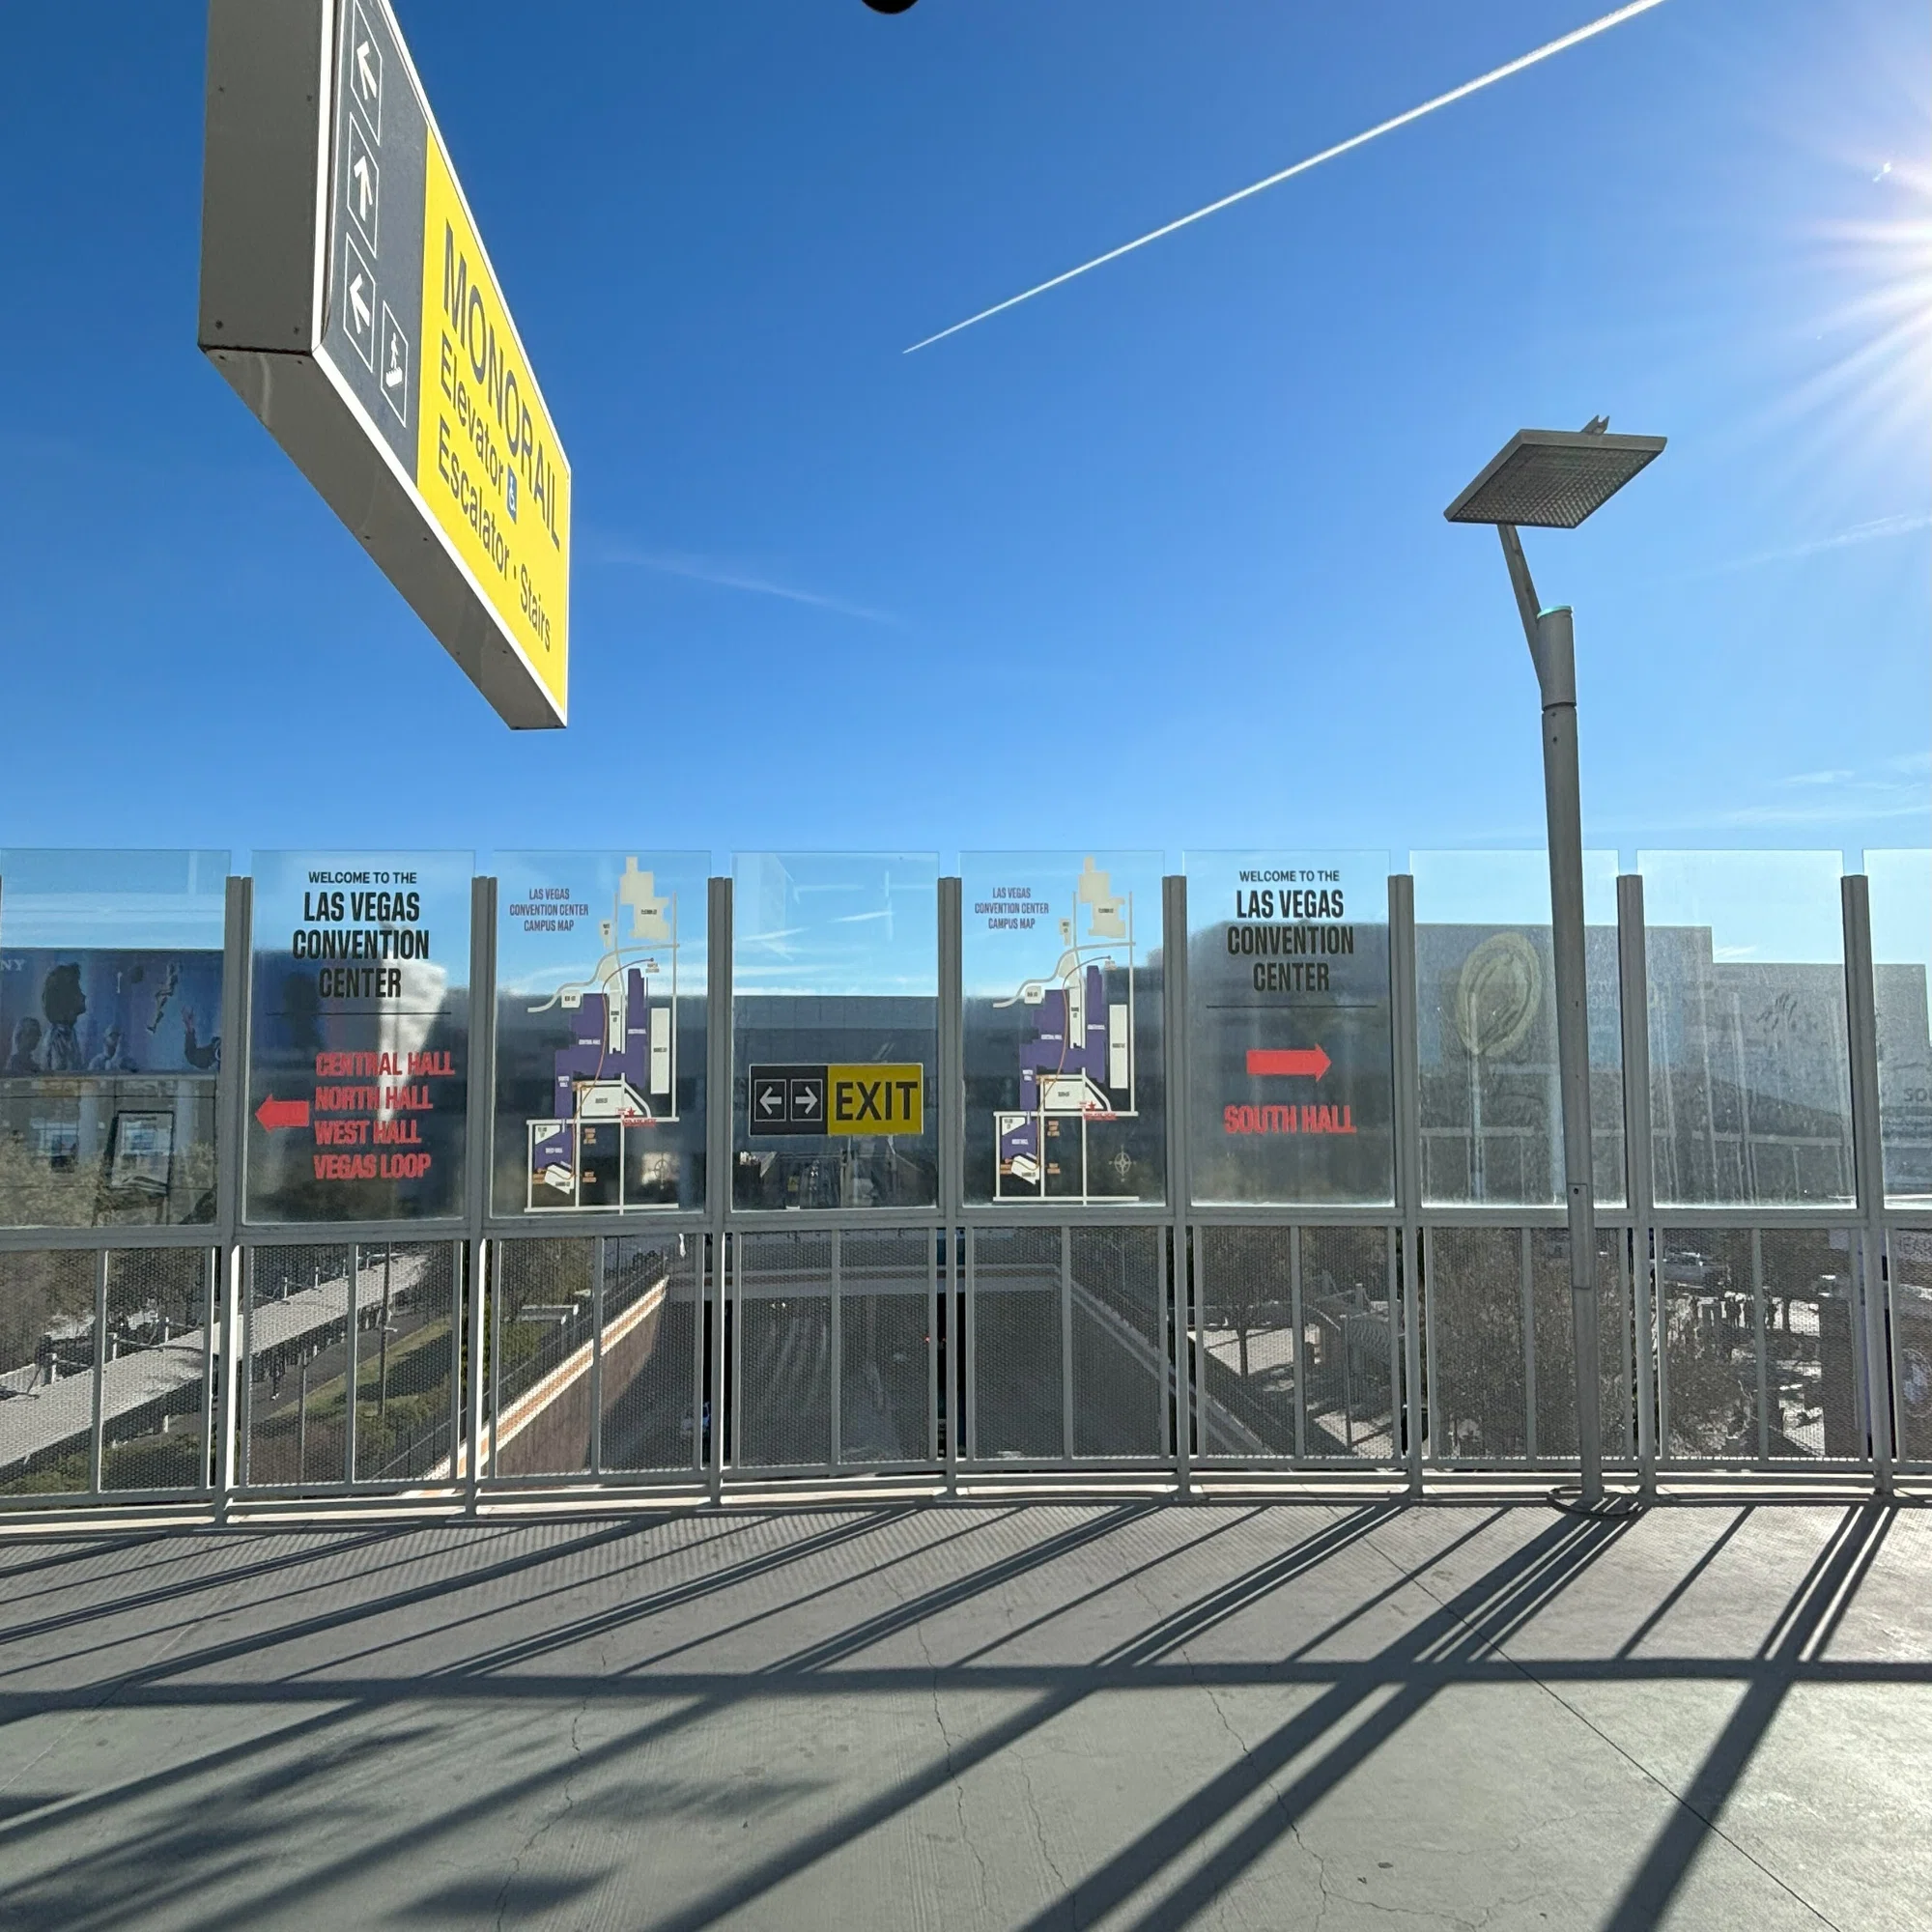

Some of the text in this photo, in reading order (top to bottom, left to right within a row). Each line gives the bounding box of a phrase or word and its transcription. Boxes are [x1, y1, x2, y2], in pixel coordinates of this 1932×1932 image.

[443, 217, 560, 553] MONORAIL
[440, 328, 504, 489] Elevator
[438, 413, 551, 653] Escalator Stairs
[308, 871, 417, 884] WELCOME TO THE
[1239, 870, 1340, 882] WELCOME TO THE
[528, 888, 570, 900] LAS VEGAS
[992, 887, 1031, 898] LAS VEGAS
[1236, 889, 1344, 919] LAS VEGAS
[304, 892, 420, 922] LAS VEGAS
[509, 903, 589, 916] CONVENTION CENTER
[974, 902, 1049, 914] CONVENTION CENTER
[524, 920, 575, 932] CAMPUS MAP
[988, 918, 1036, 929] CAMPUS MAP
[293, 929, 429, 960] CONVENTION
[1227, 925, 1353, 955] CONVENTION
[319, 967, 402, 998] CENTER
[1253, 962, 1330, 991] CENTER
[316, 1050, 456, 1077] CENTRAL HALL
[315, 1085, 434, 1111] NORTH HALL
[836, 1081, 919, 1121] EXIT
[1903, 1087, 1932, 1102] SO
[314, 1120, 422, 1146] WEST HALL
[1224, 1104, 1357, 1135] SOUTH HALL
[313, 1152, 432, 1179] VEGAS LOOP
